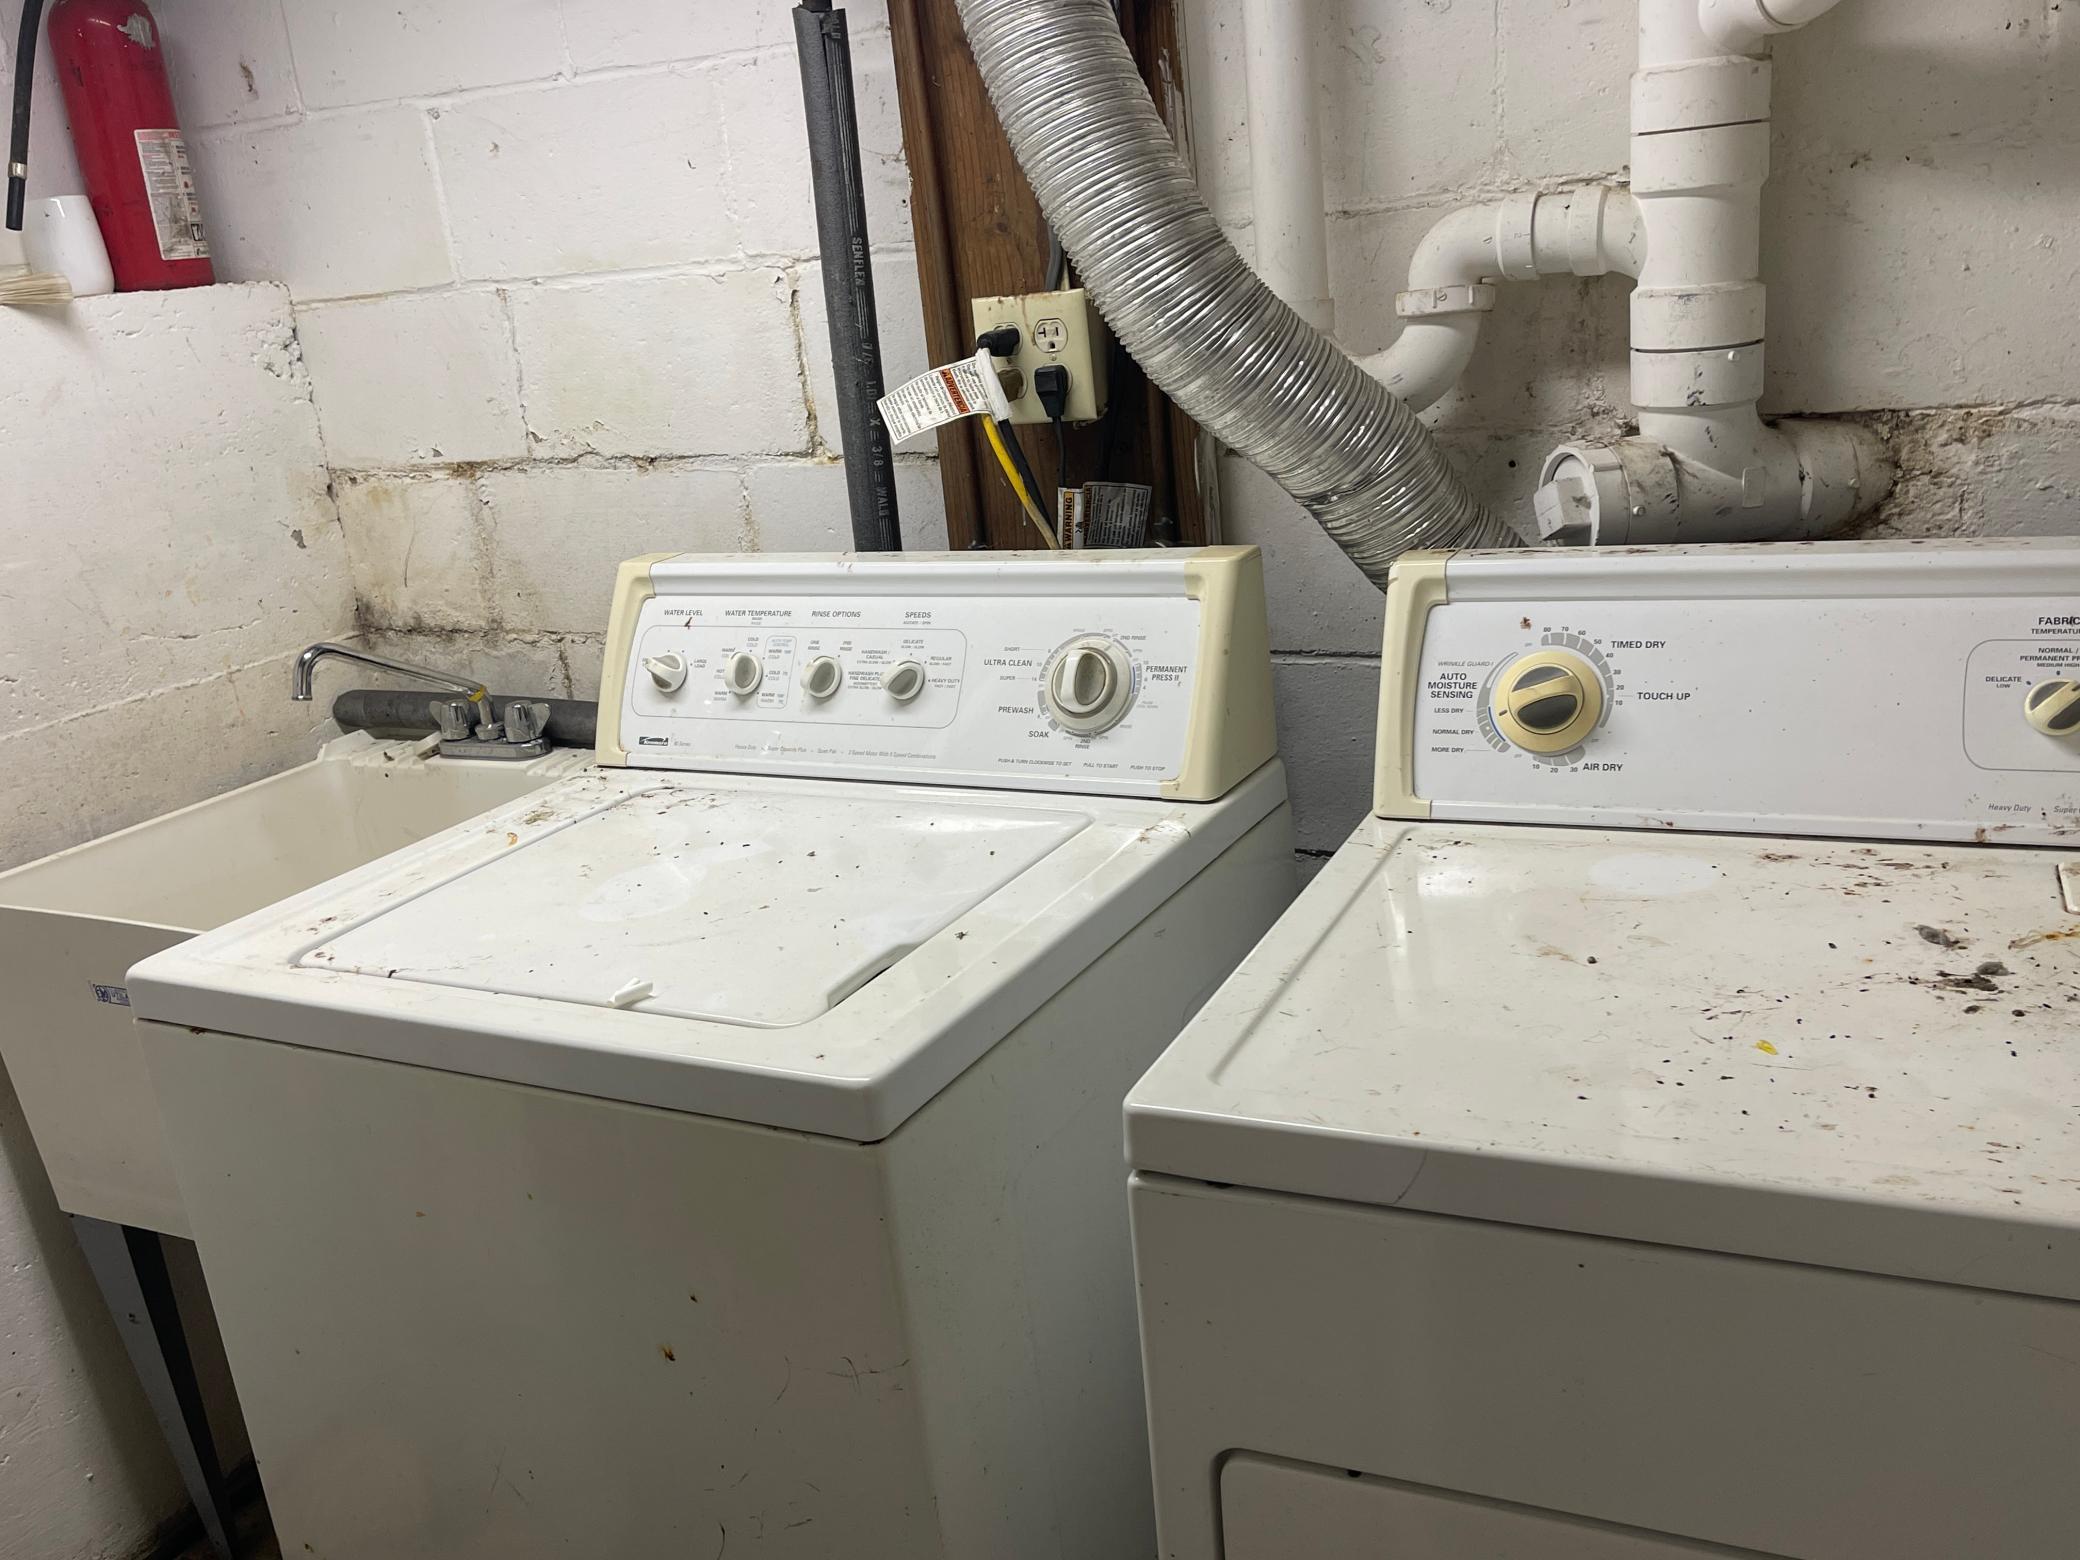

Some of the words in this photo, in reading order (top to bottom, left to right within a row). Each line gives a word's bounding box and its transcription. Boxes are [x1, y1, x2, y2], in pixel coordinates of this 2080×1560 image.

[1064, 497, 1073, 539] WARNING
[725, 609, 746, 617] WATER
[905, 611, 932, 619] SPEEDS
[1611, 640, 1643, 649] TIMED
[1645, 641, 1666, 649] DRY
[1008, 659, 1032, 667] CLEAN
[1440, 672, 1467, 681] AUTO
[1427, 682, 1477, 690] MOISTURE
[1430, 690, 1473, 699] SENSING
[1637, 692, 1673, 701] TOUCH
[1676, 692, 1691, 701] UP
[998, 706, 1034, 714] PREWASH
[1028, 730, 1050, 738] SOAK
[1583, 762, 1600, 771] AIR
[1602, 763, 1623, 772] DRY
[1988, 803, 2012, 812] Heavy
[2013, 803, 2032, 813] Duty
[2053, 805, 2078, 814] Super
